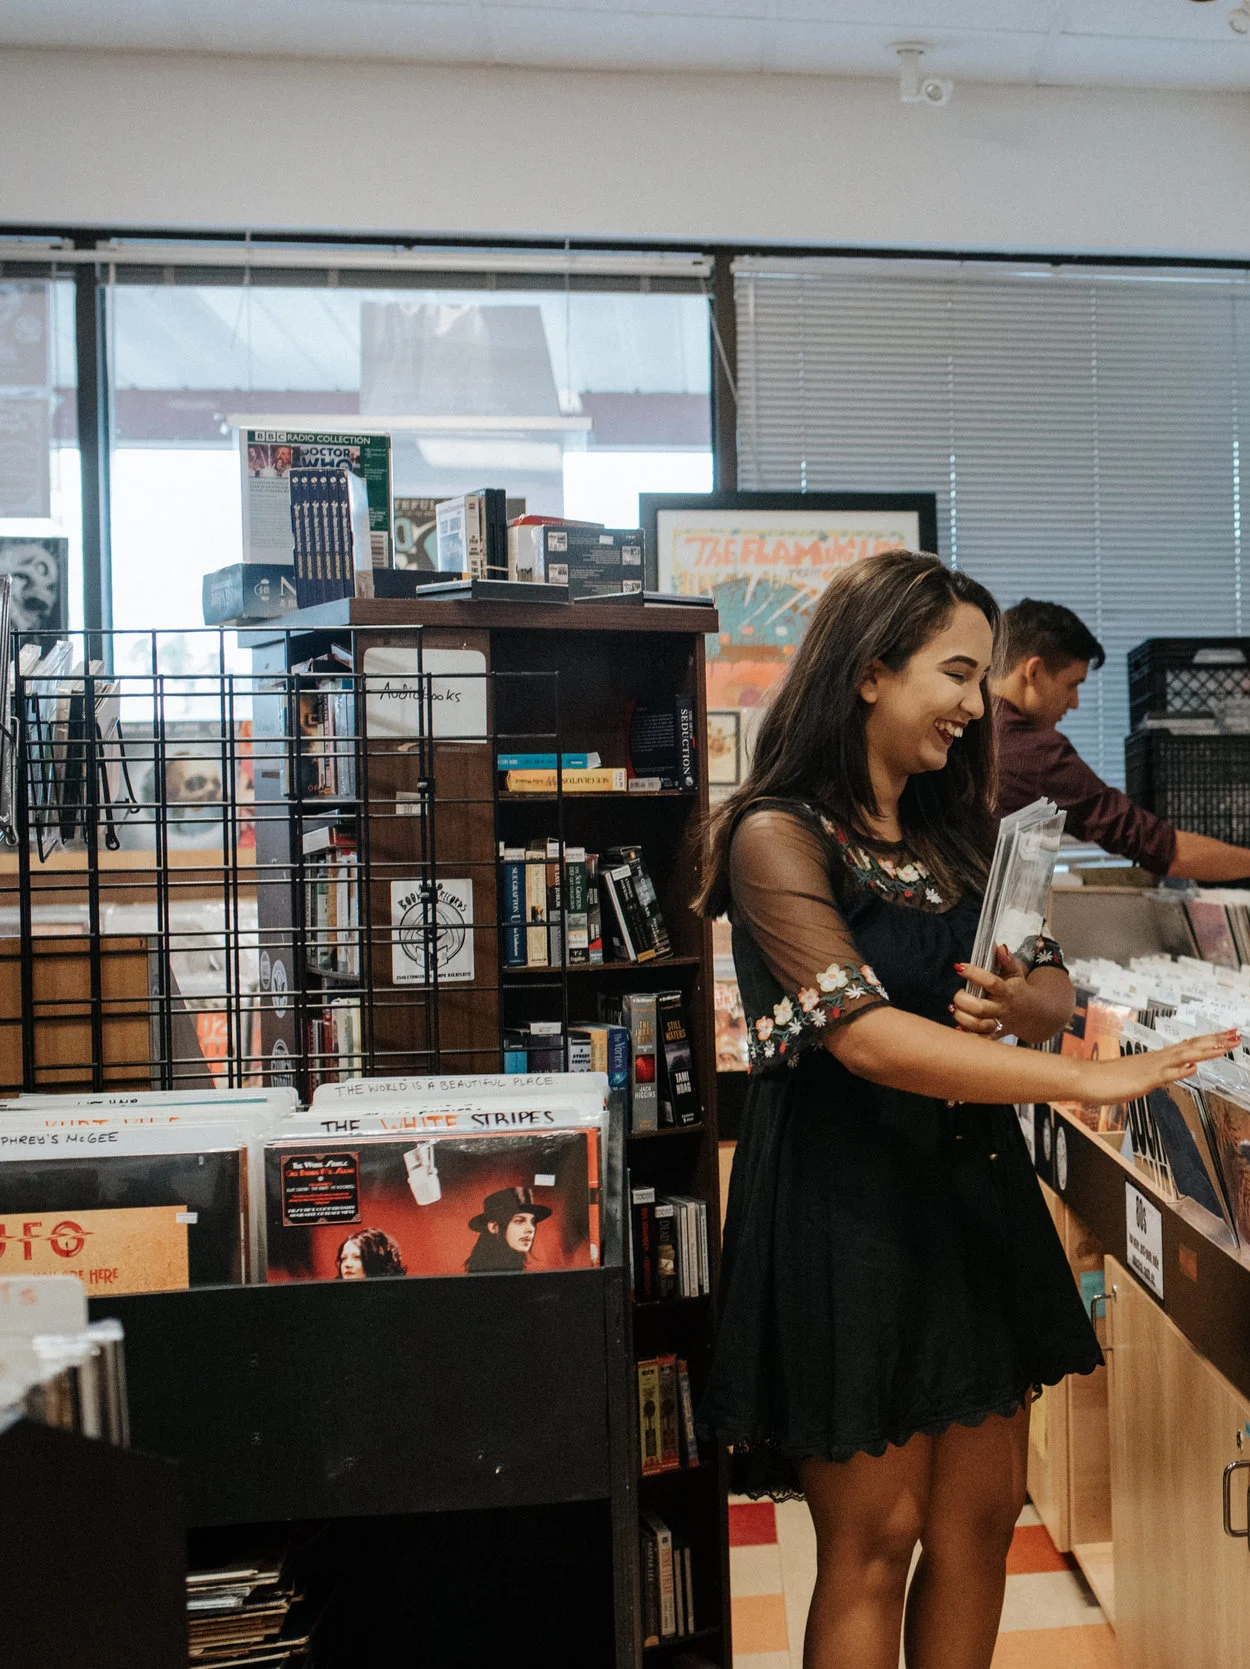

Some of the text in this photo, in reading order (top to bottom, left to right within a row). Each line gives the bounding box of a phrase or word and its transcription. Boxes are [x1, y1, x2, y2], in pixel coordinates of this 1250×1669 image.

[255, 432, 370, 445] BBC RADIO COLLECTION
[300, 447, 350, 458] DOCTOR
[680, 708, 692, 776] SEDUCTION
[575, 887, 584, 912] GRAFTON
[667, 1020, 681, 1032] STILL
[665, 1029, 686, 1041] WATERS
[614, 1040, 626, 1068] Vortex
[675, 1072, 690, 1082] TAMI
[335, 1086, 366, 1097] THE
[369, 1082, 408, 1093] WORLD
[412, 1082, 423, 1091] IS
[427, 1081, 436, 1090] A
[440, 1077, 506, 1091] BEAUTIFUL
[676, 1082, 692, 1095] HOAG
[634, 1091, 656, 1100] HIGGINS
[321, 1111, 555, 1132] THE WHITE STRIPES
[66, 1131, 119, 1143] McGEE
[89, 1267, 119, 1285] HERE
